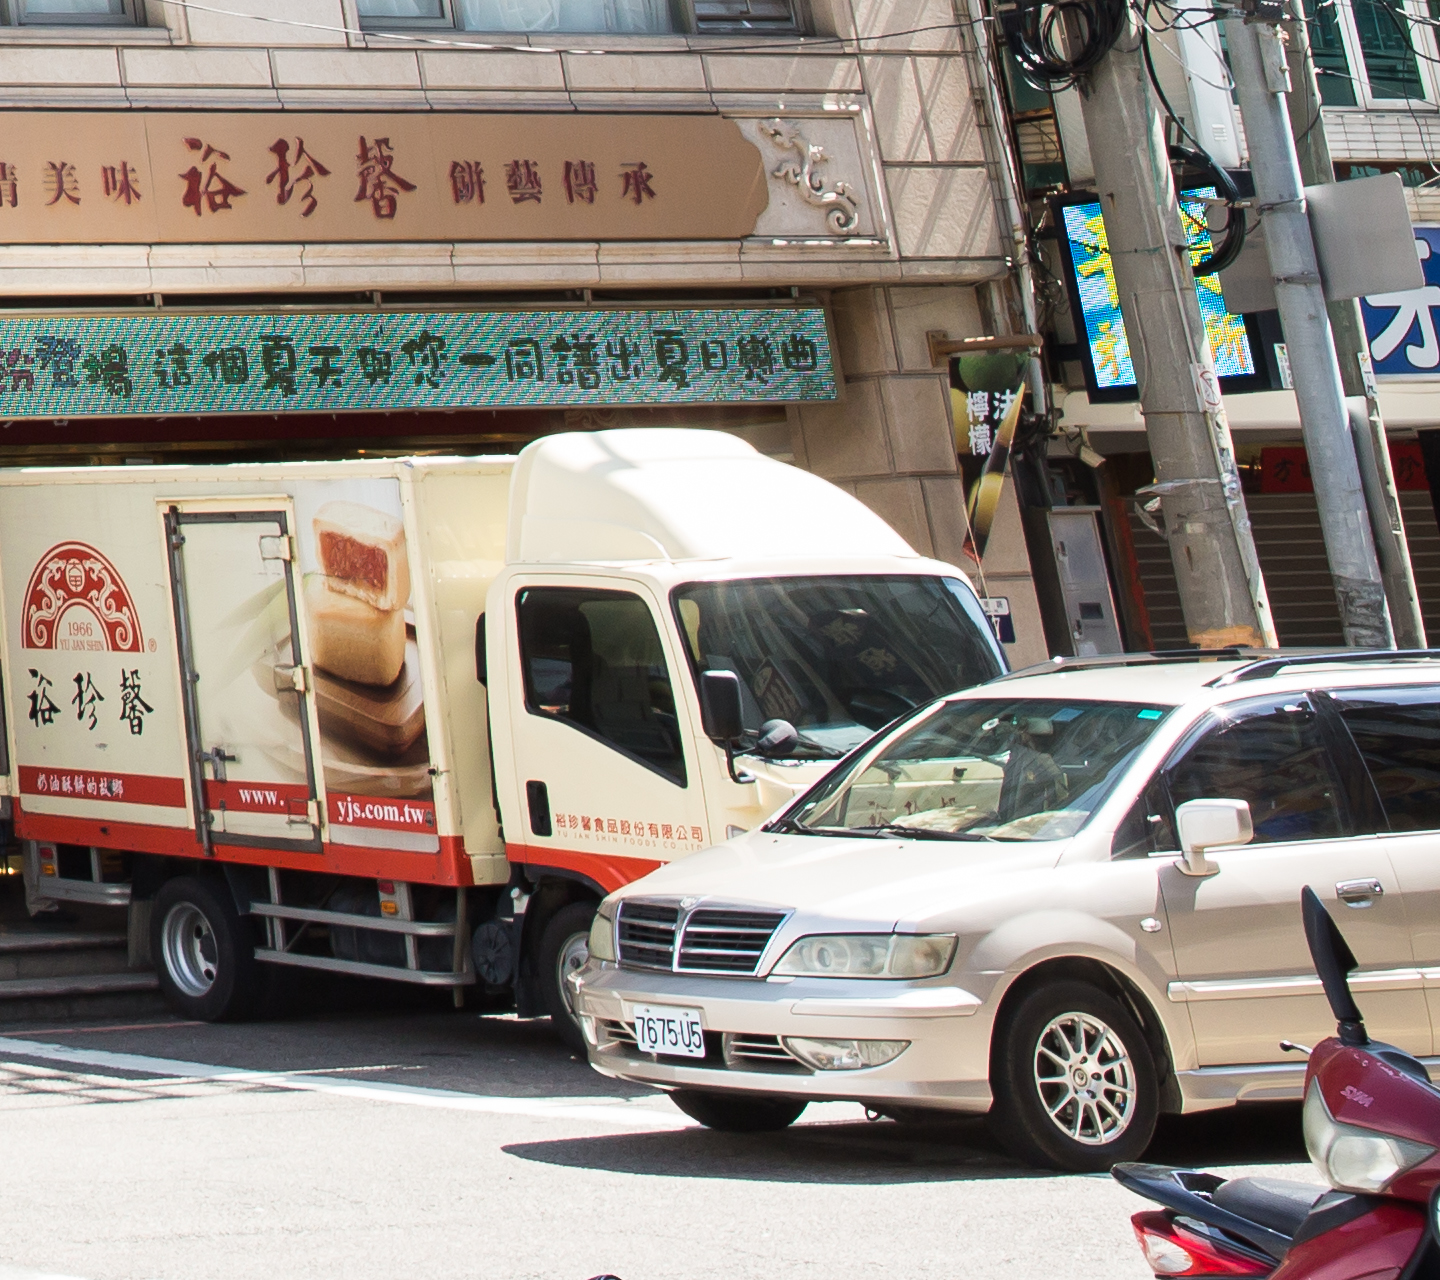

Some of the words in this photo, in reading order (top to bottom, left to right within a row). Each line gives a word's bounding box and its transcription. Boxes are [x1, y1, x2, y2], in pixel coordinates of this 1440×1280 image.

[180, 137, 418, 220] 裕珍馨
[449, 159, 658, 205] 餅藝傳承
[965, 391, 990, 457] 檸檬
[60, 638, 71, 650] YU
[71, 640, 86, 651] JAN
[86, 641, 105, 652] SHIN
[67, 621, 93, 637] 1966
[26, 667, 155, 736] 裕珍馨
[36, 772, 125, 799] 奶油酥餅的故鄉
[238, 788, 285, 807] www.
[336, 796, 425, 824] yjs.com.tw
[555, 812, 704, 843] 裕珍馨食品股份有限公司
